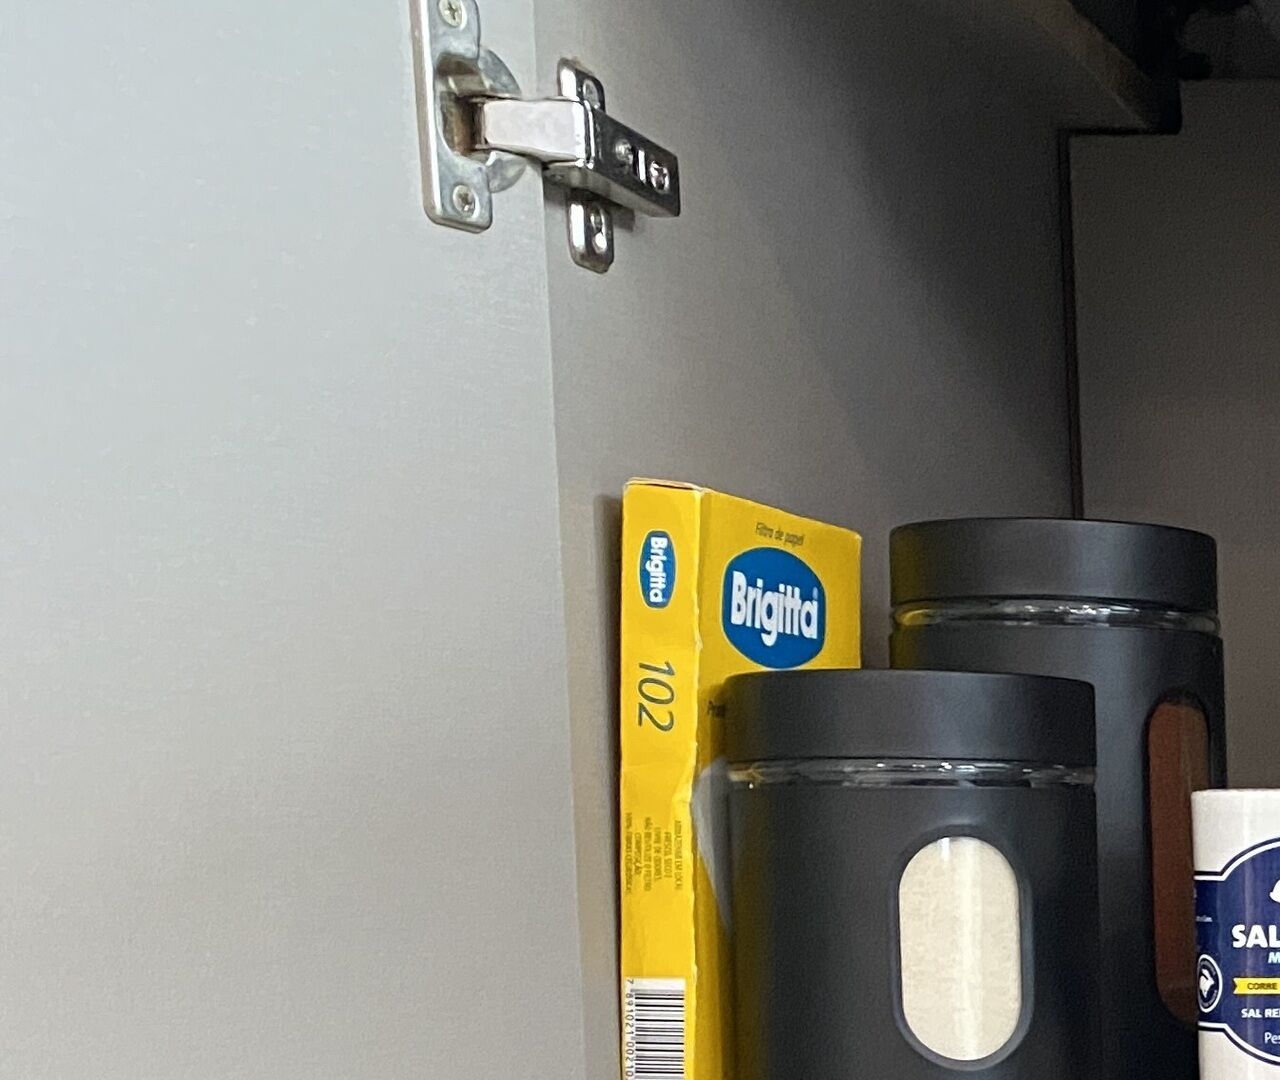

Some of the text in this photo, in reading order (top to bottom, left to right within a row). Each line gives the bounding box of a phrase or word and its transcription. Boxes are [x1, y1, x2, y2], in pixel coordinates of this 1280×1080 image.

[645, 536, 669, 604] Brigitta
[730, 570, 819, 647] Brigitta
[638, 660, 676, 732] 102
[1241, 1008, 1263, 1018] SAL
[1247, 982, 1278, 990] CORRE
